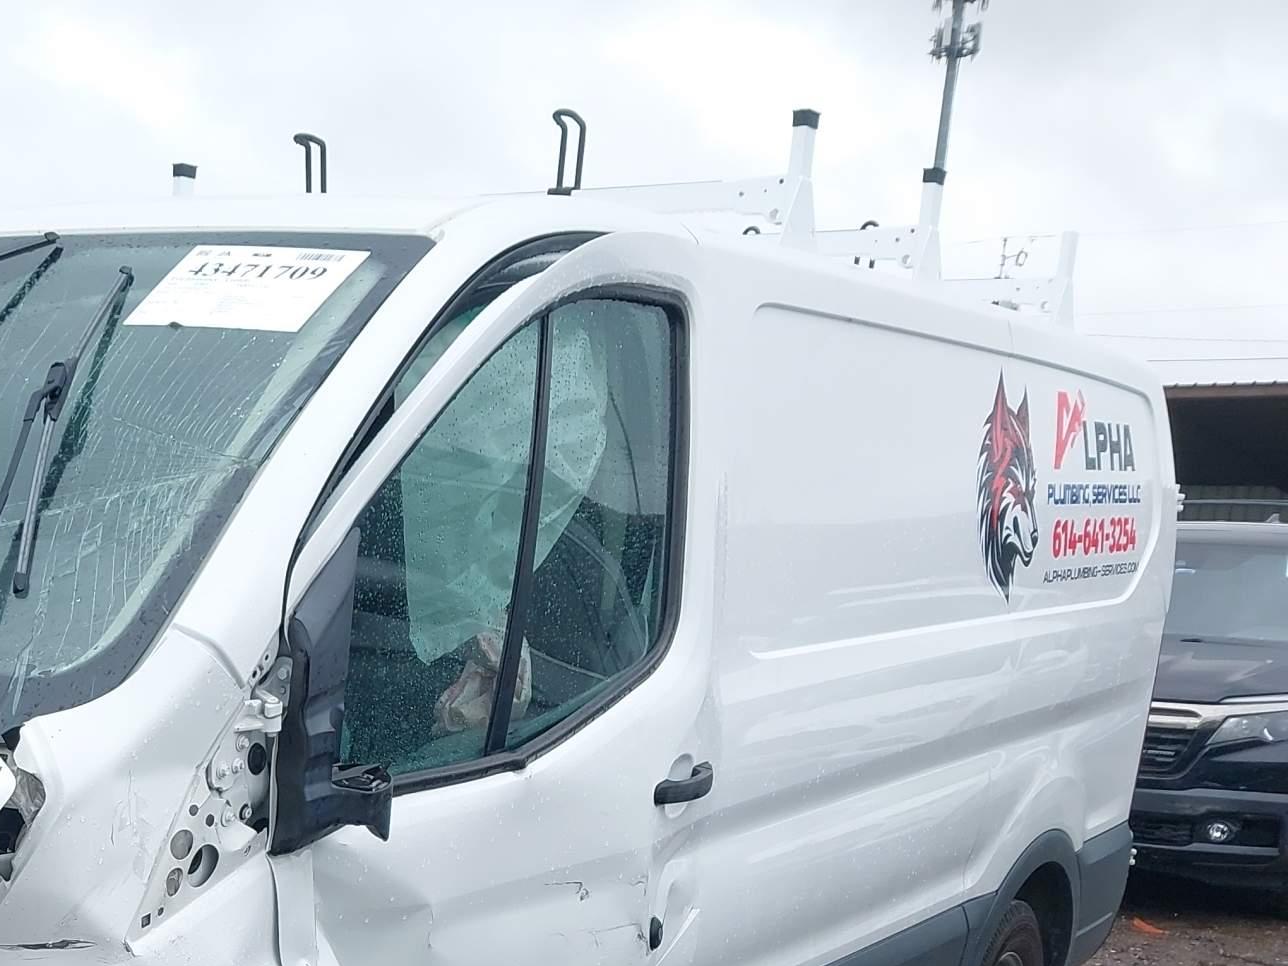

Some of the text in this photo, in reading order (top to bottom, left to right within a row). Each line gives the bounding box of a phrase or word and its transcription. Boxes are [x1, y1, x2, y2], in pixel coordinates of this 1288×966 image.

[188, 262, 328, 280] 43471709
[1092, 484, 1127, 504] SERVICES
[1128, 484, 1141, 503] LLC
[1053, 517, 1136, 558] 614-641-3254
